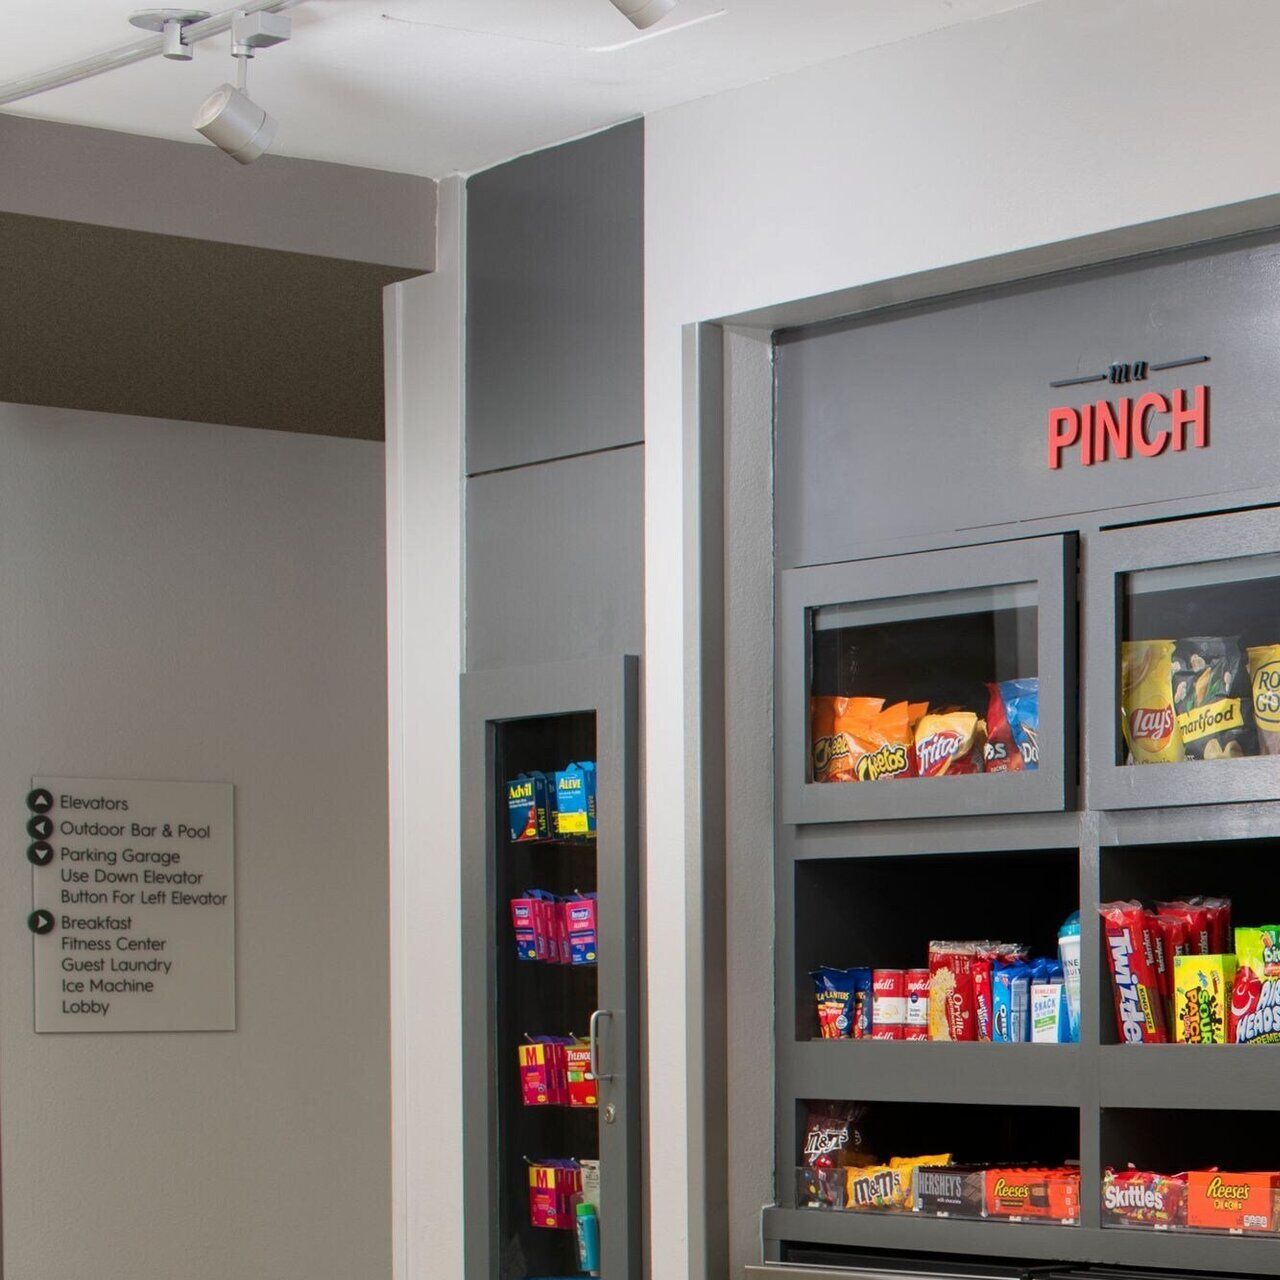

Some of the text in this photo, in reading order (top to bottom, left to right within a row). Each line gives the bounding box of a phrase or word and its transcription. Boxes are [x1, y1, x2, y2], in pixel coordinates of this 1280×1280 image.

[1048, 385, 1208, 469] PINCH
[1133, 707, 1172, 739] Lay's
[1180, 704, 1234, 737] martfood
[918, 733, 964, 775] Fritos
[509, 783, 532, 799] Advil
[60, 795, 129, 811] Elevators
[60, 822, 211, 838] Outdoor Bar & Pool
[61, 848, 180, 866] Parking Garage
[61, 869, 203, 885] Use Down Elevator
[61, 890, 227, 906] Button For Left Elevator
[61, 916, 132, 930] Breakfast
[61, 937, 167, 951] Fitness Center
[61, 958, 172, 975] Guest Laundry
[62, 980, 154, 993] Ice Machine
[1139, 987, 1150, 1009] KING
[62, 1000, 110, 1016] Lobby
[1199, 989, 1213, 1044] SOUR
[919, 1172, 962, 1197] HERSHEY'S
[994, 1178, 1029, 1198] Reese's
[1207, 1177, 1250, 1199] Reese's
[1105, 1184, 1163, 1209] Skittles
